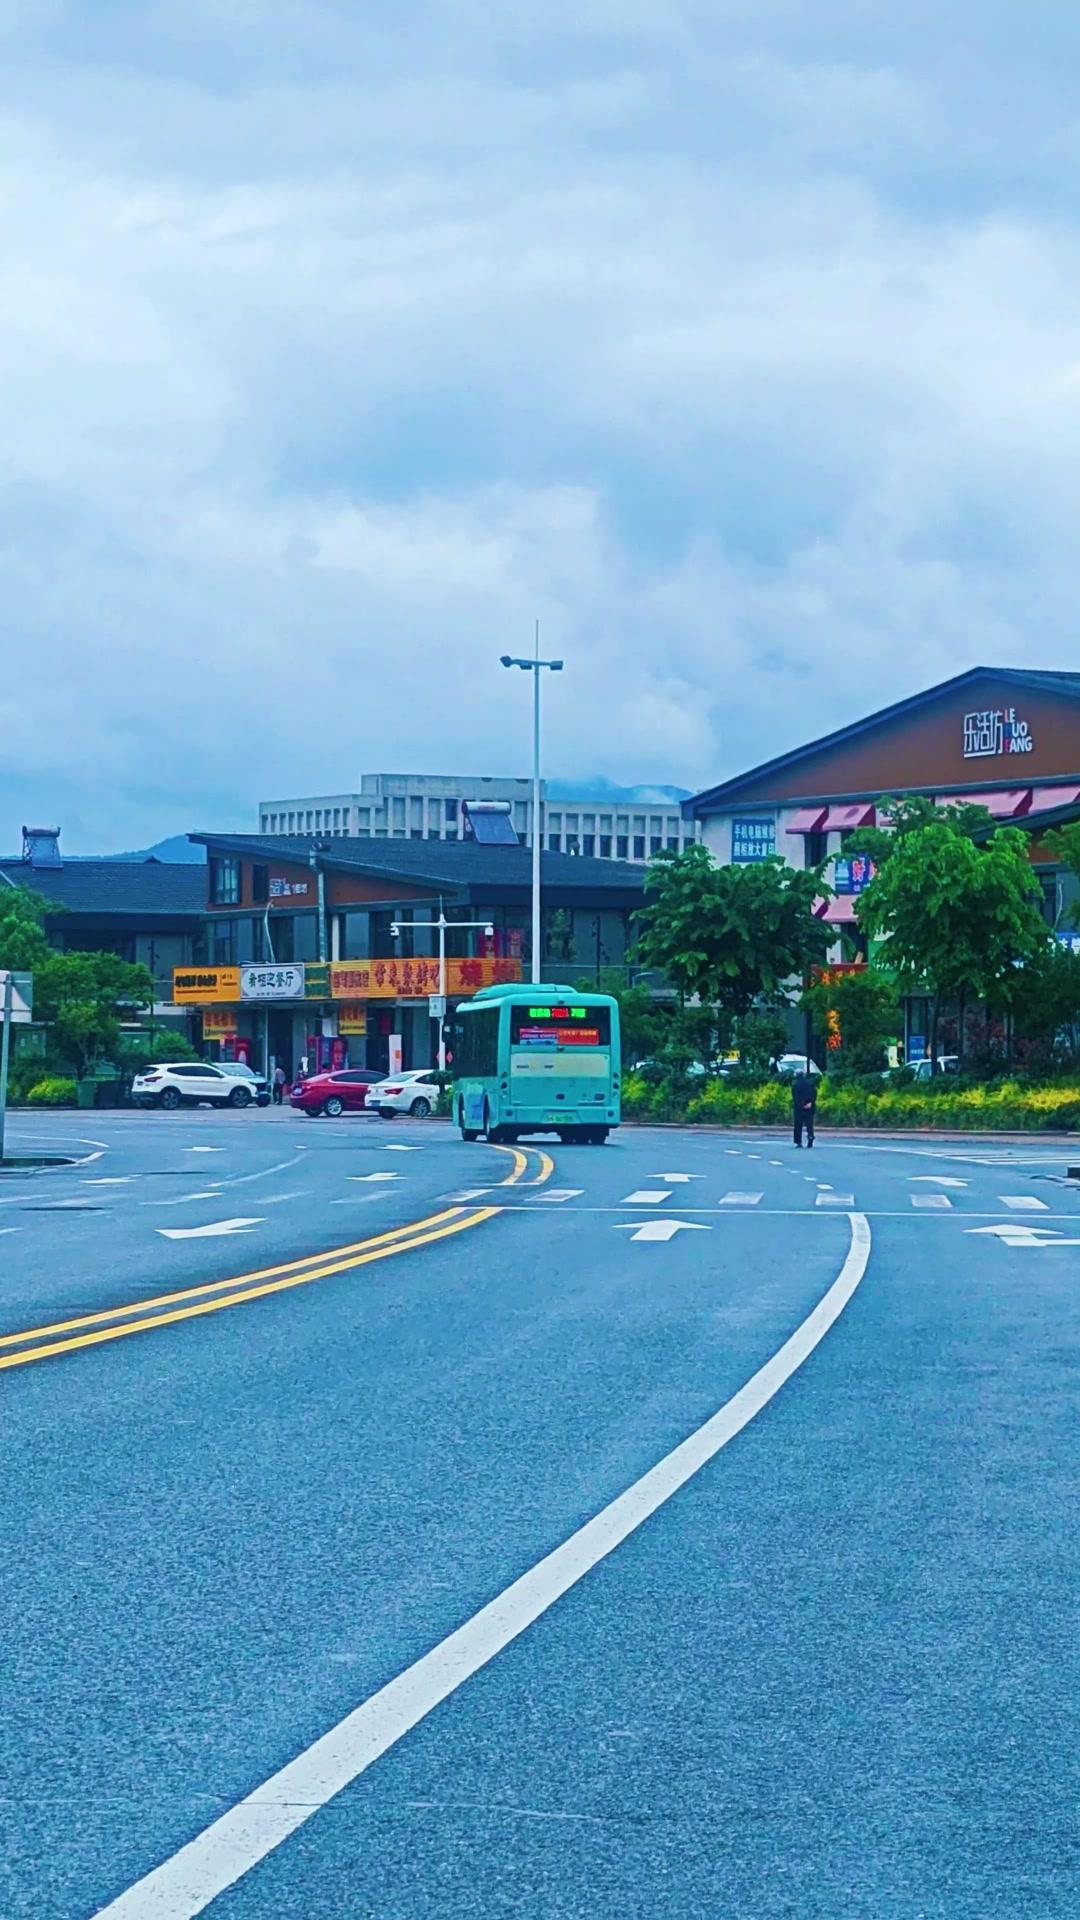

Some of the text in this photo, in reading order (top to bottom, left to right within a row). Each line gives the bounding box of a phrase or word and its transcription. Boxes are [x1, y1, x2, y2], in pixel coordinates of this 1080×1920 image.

[1004, 708, 1016, 724] LE
[964, 709, 1003, 758] 乐活坊
